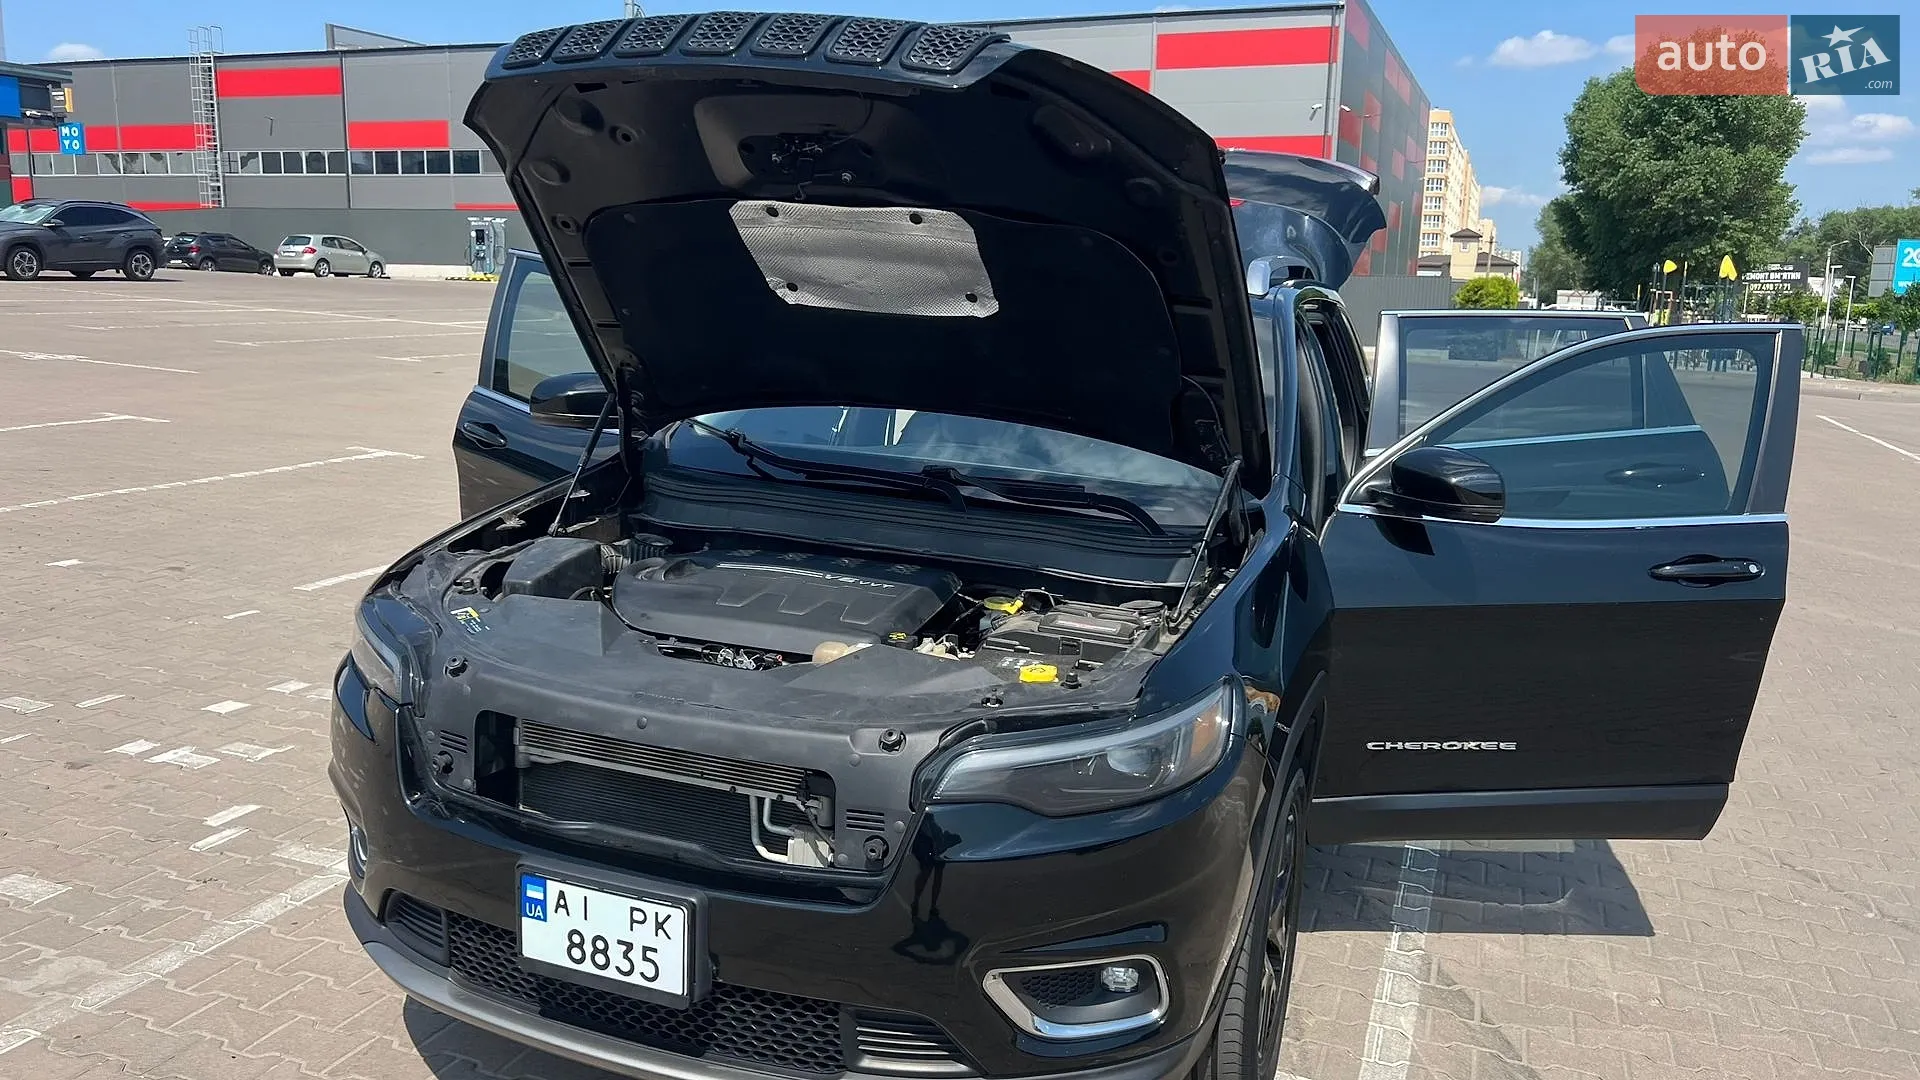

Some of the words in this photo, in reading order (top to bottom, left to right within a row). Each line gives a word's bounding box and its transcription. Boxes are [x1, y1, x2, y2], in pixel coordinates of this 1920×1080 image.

[61, 126, 79, 137] MO
[62, 139, 80, 150] YO
[1366, 741, 1518, 750] CHEROKEE
[525, 902, 544, 919] UA
[554, 889, 589, 921] AI
[630, 906, 672, 940] PK
[566, 928, 660, 983] 8835
